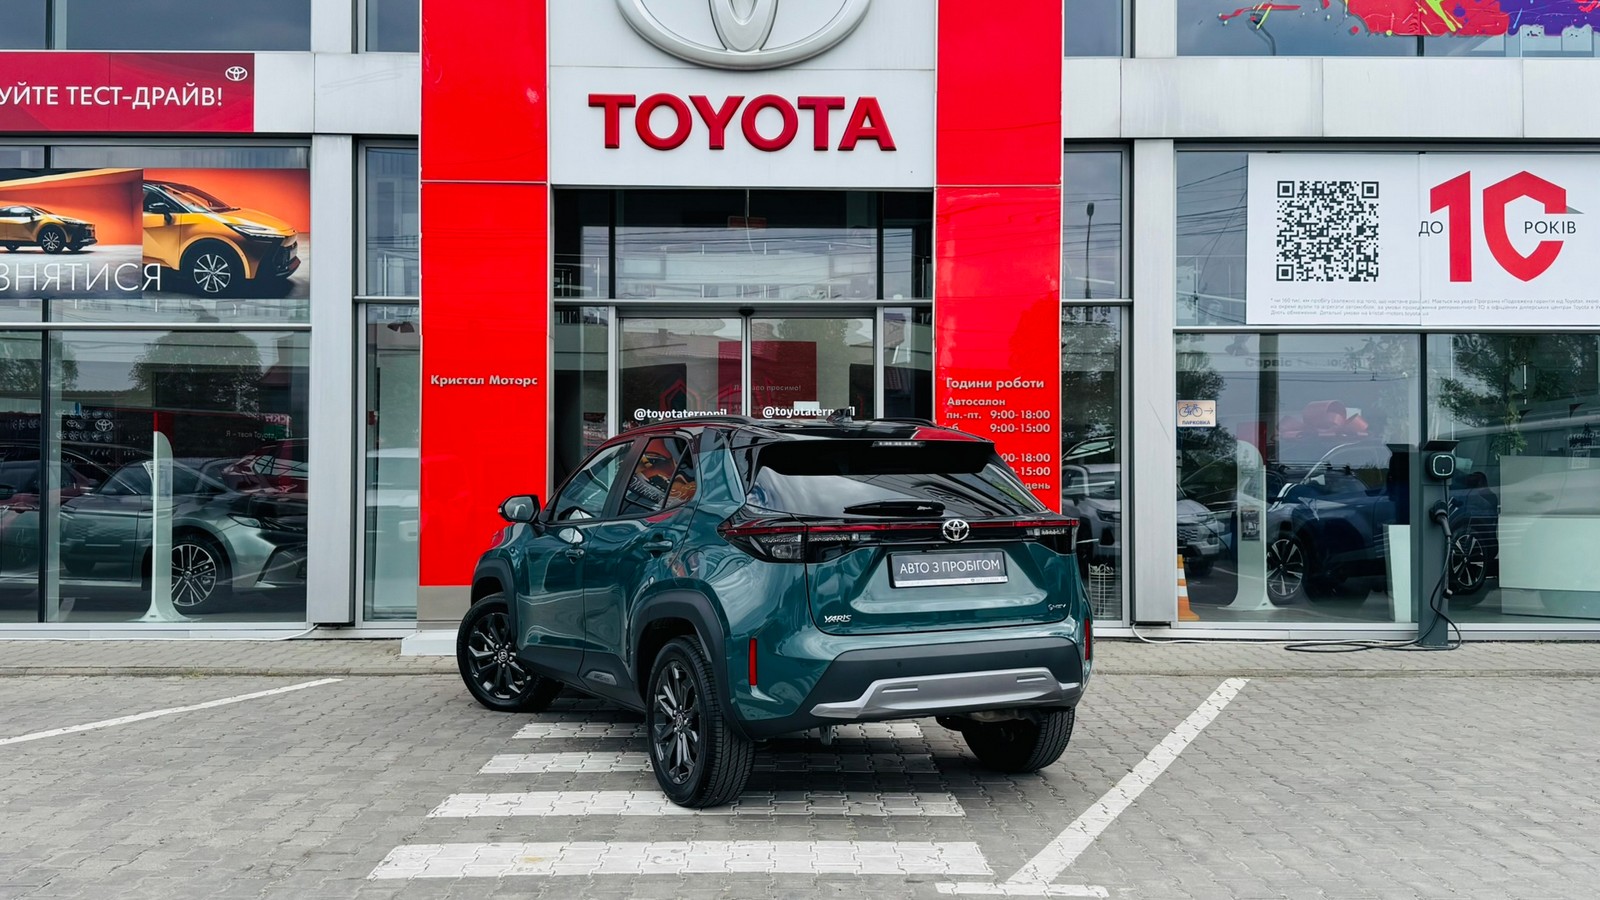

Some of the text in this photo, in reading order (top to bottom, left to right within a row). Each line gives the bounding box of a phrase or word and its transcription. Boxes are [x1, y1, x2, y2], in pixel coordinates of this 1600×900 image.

[66, 82, 222, 110] ТЕСТ-ДРАЙВ!
[588, 92, 897, 152] TOYOTA
[1418, 220, 1444, 236] ДО
[1524, 220, 1576, 234] РОКІВ
[430, 374, 538, 387] Кристал Моторс
[946, 376, 1044, 391] Години роботи
[946, 396, 1006, 406] Автосалон
[990, 410, 1050, 419] 9:00-18:00
[990, 423, 1050, 432] 9:00-15:00
[900, 562, 930, 574] АВТО
[942, 559, 1000, 572] ПРОБІГОМ
[824, 614, 852, 623] YARIS
